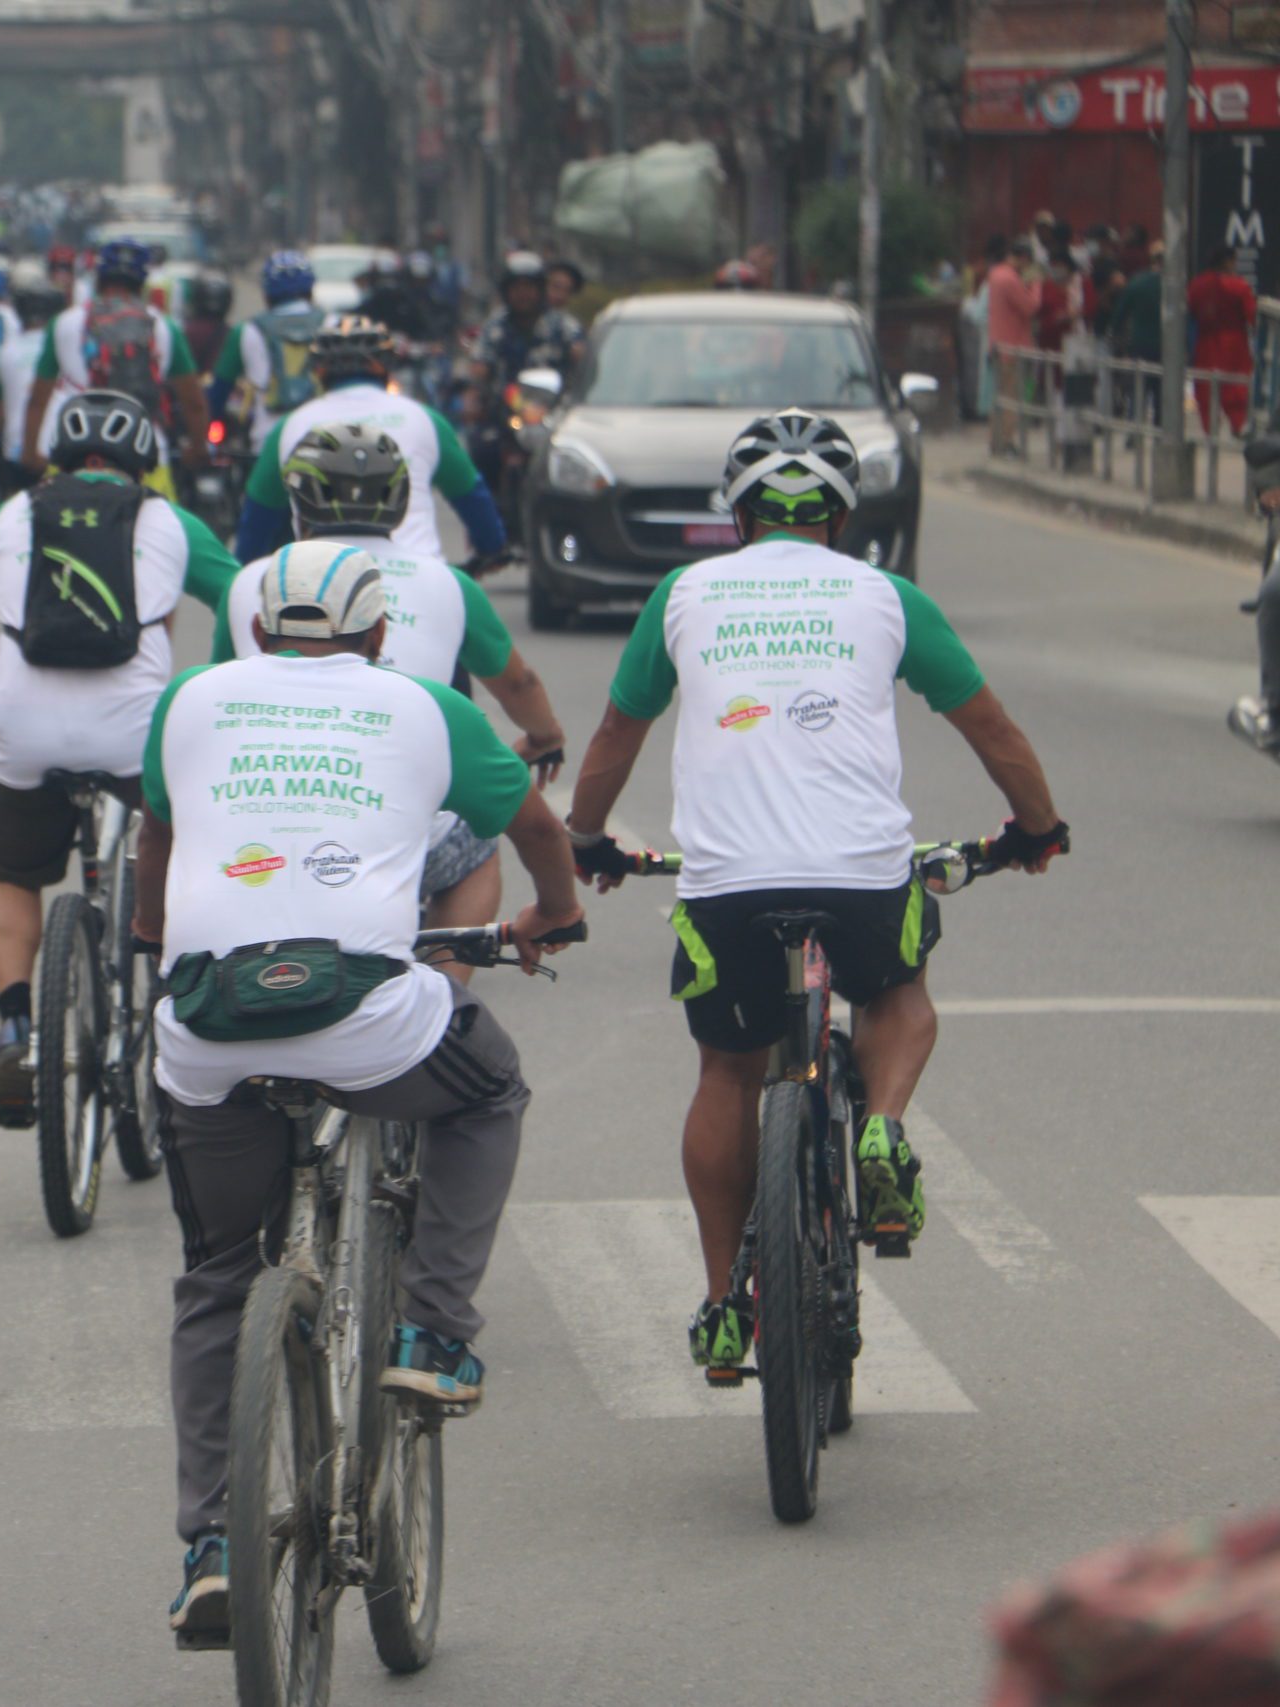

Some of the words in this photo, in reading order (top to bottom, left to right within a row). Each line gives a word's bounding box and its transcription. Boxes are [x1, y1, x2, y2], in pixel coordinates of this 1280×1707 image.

[716, 619, 834, 641] MARWADI
[700, 641, 759, 666] YUVA
[766, 639, 855, 661] MANCH
[786, 697, 839, 718] Prakash
[229, 754, 364, 779] MARWADI
[211, 777, 276, 802] YUVA
[284, 777, 384, 810] MANCH
